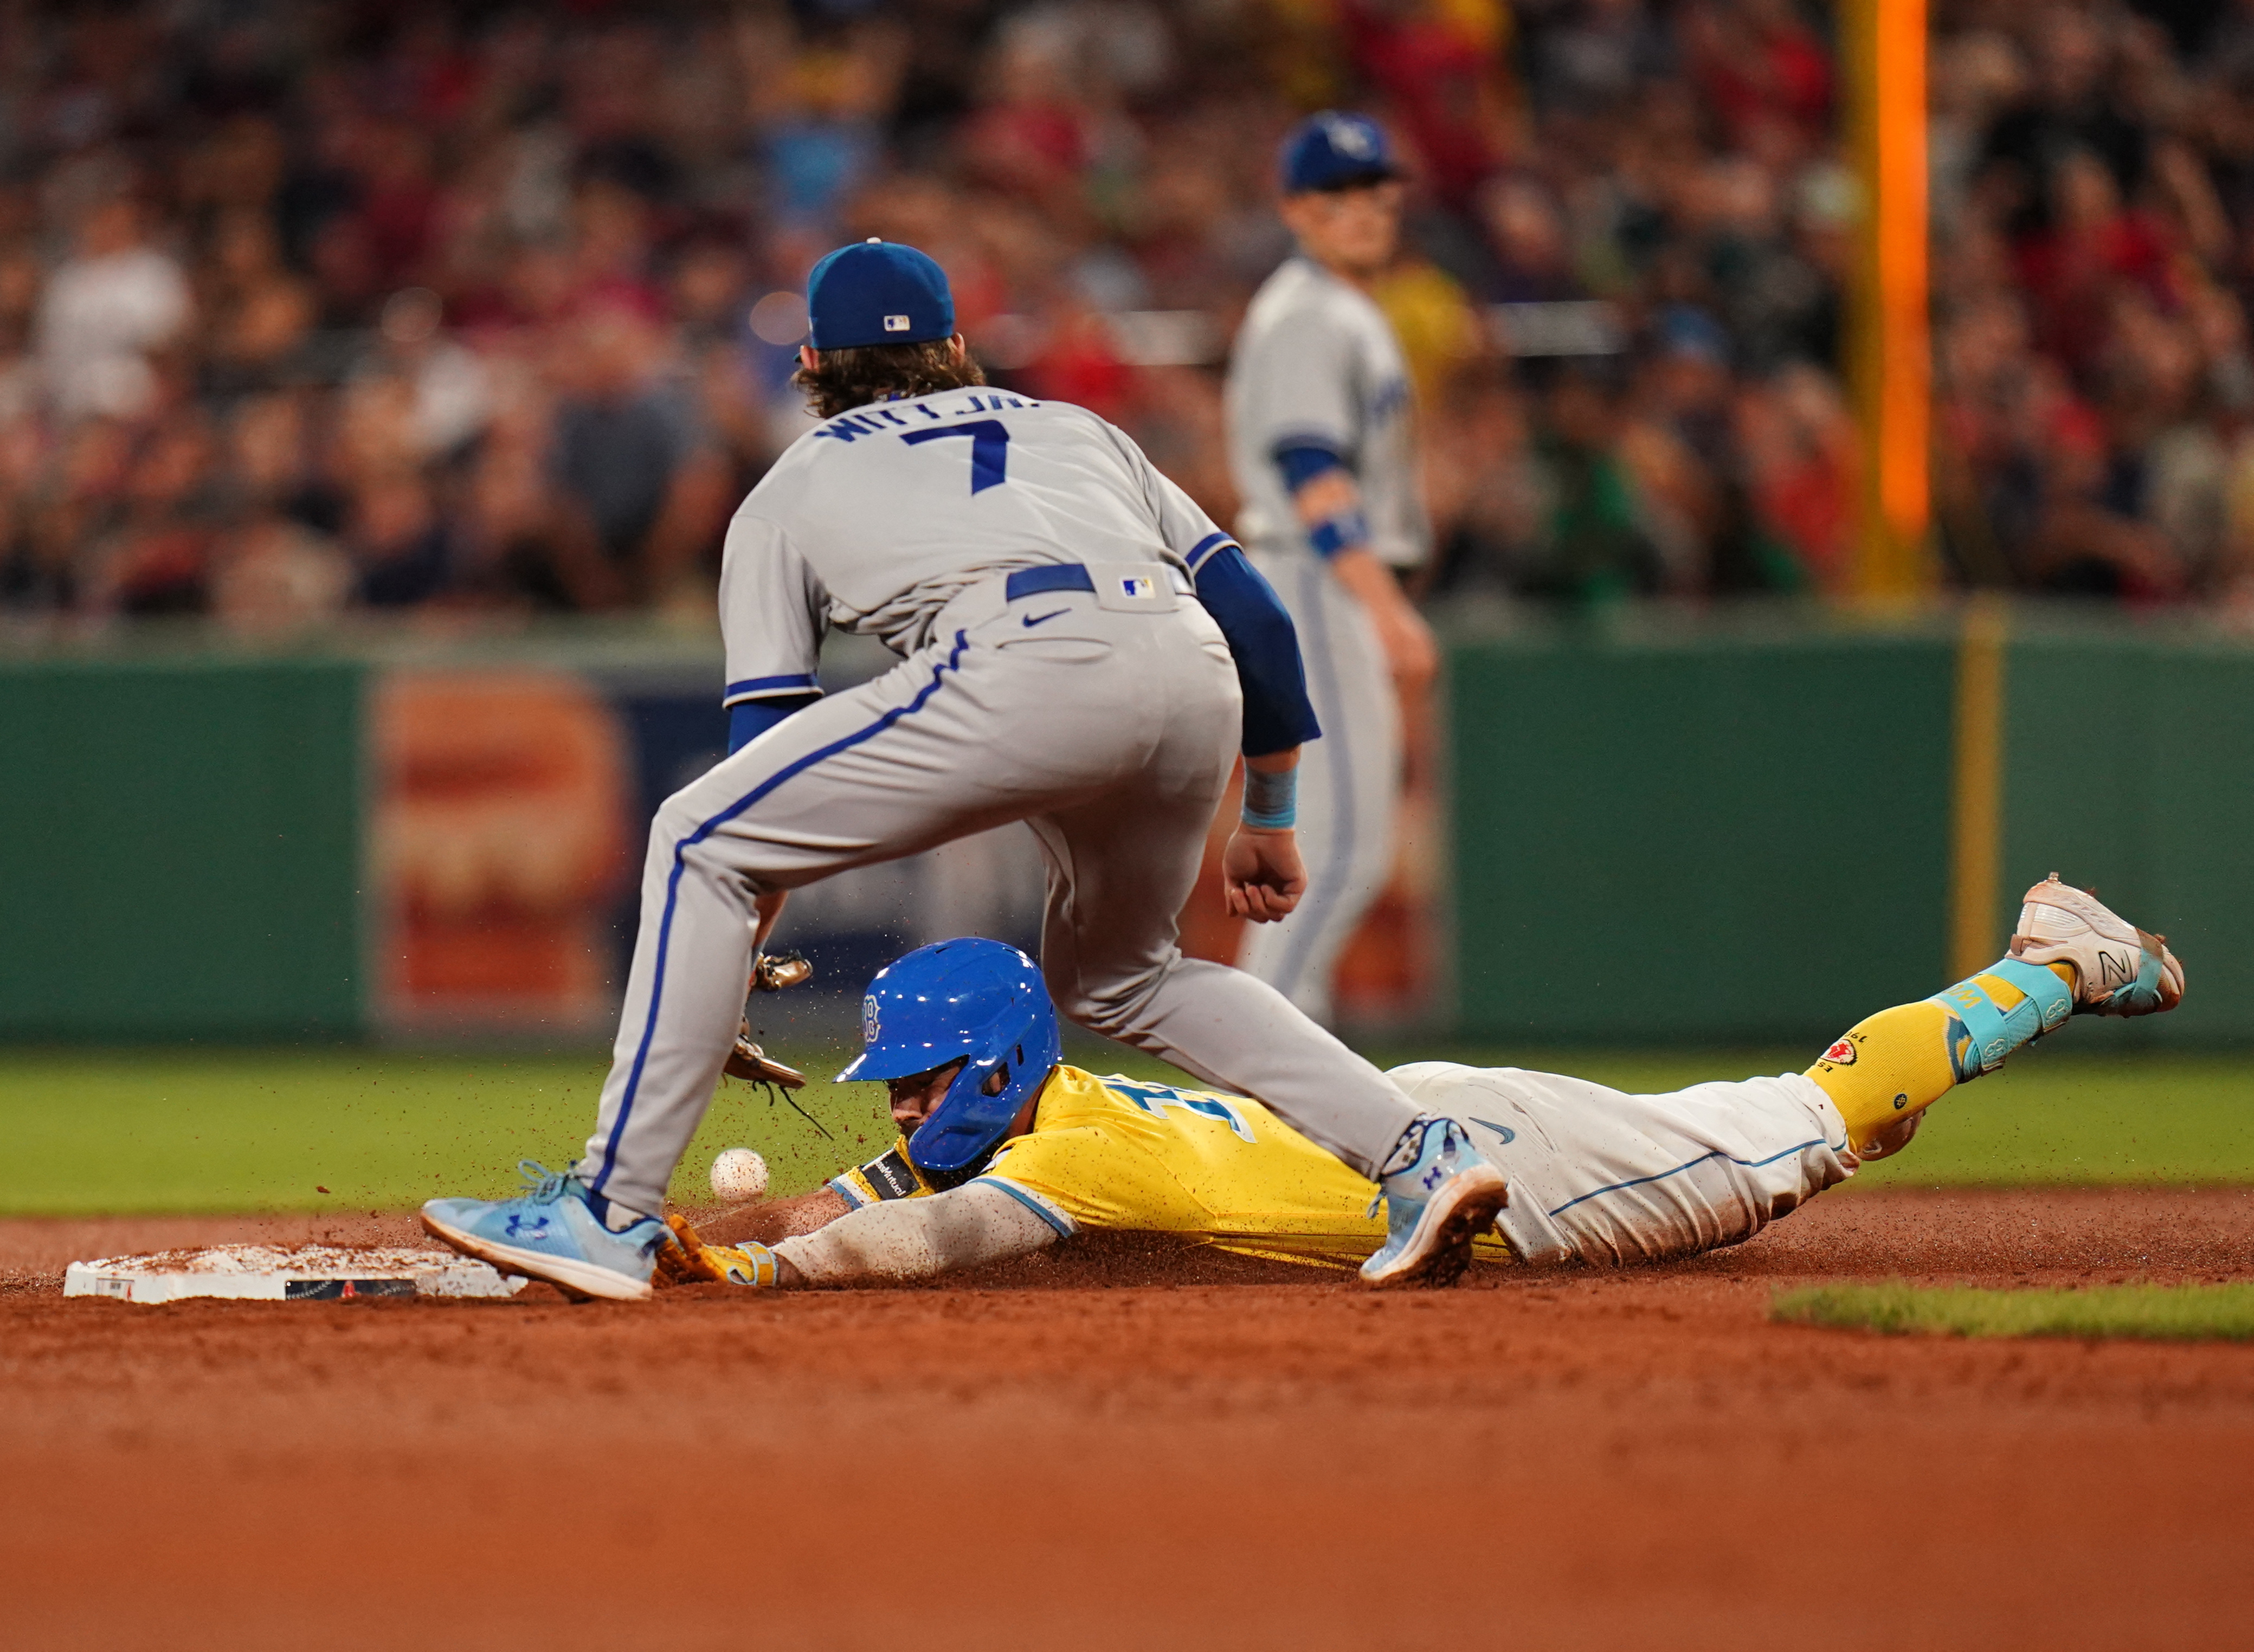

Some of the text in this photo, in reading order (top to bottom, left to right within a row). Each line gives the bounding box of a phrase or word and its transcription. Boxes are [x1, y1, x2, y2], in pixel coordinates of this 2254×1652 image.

[814, 395, 1040, 442] WITT JR.
[899, 419, 1010, 498] 7
